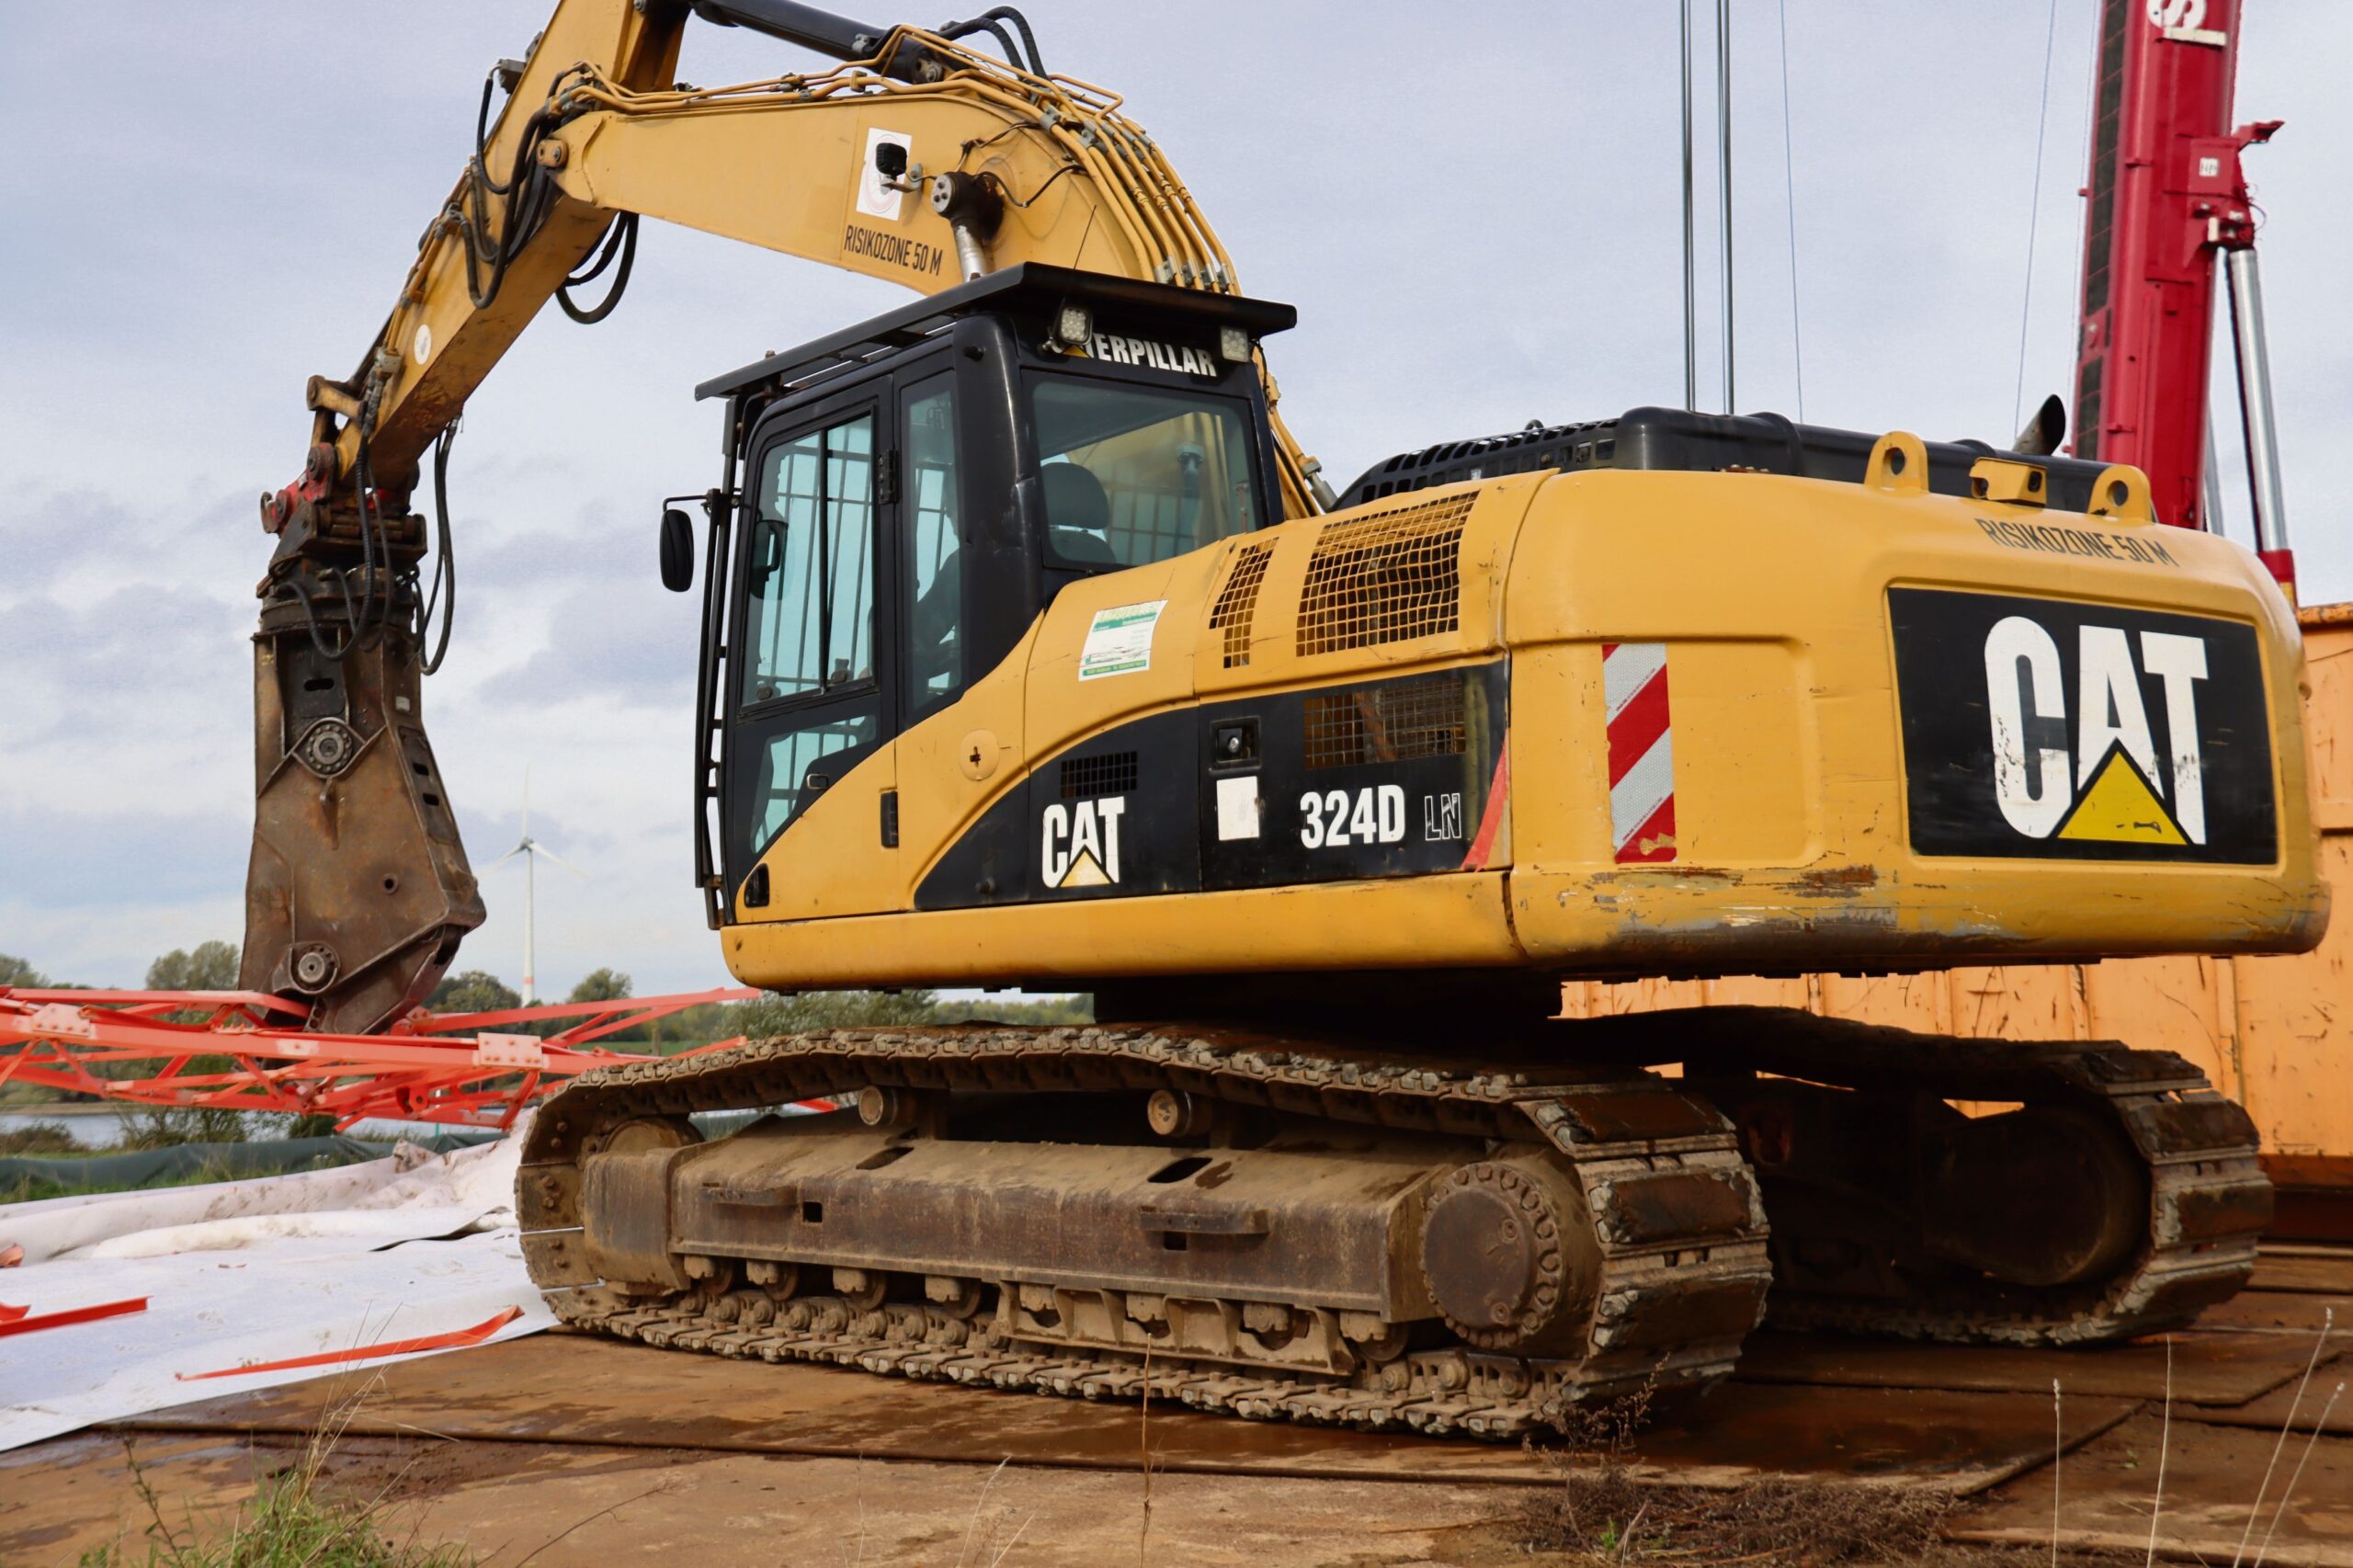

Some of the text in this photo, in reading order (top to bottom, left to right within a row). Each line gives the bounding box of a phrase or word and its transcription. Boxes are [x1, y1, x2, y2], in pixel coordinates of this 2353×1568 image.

[844, 225, 943, 276] RISIKOZONE 50 M
[1975, 518, 2180, 567] RISIKOZONE 50 M
[1984, 616, 2208, 845] CAT
[1042, 796, 1125, 888] CAT
[1300, 784, 1462, 849] 324D LN
